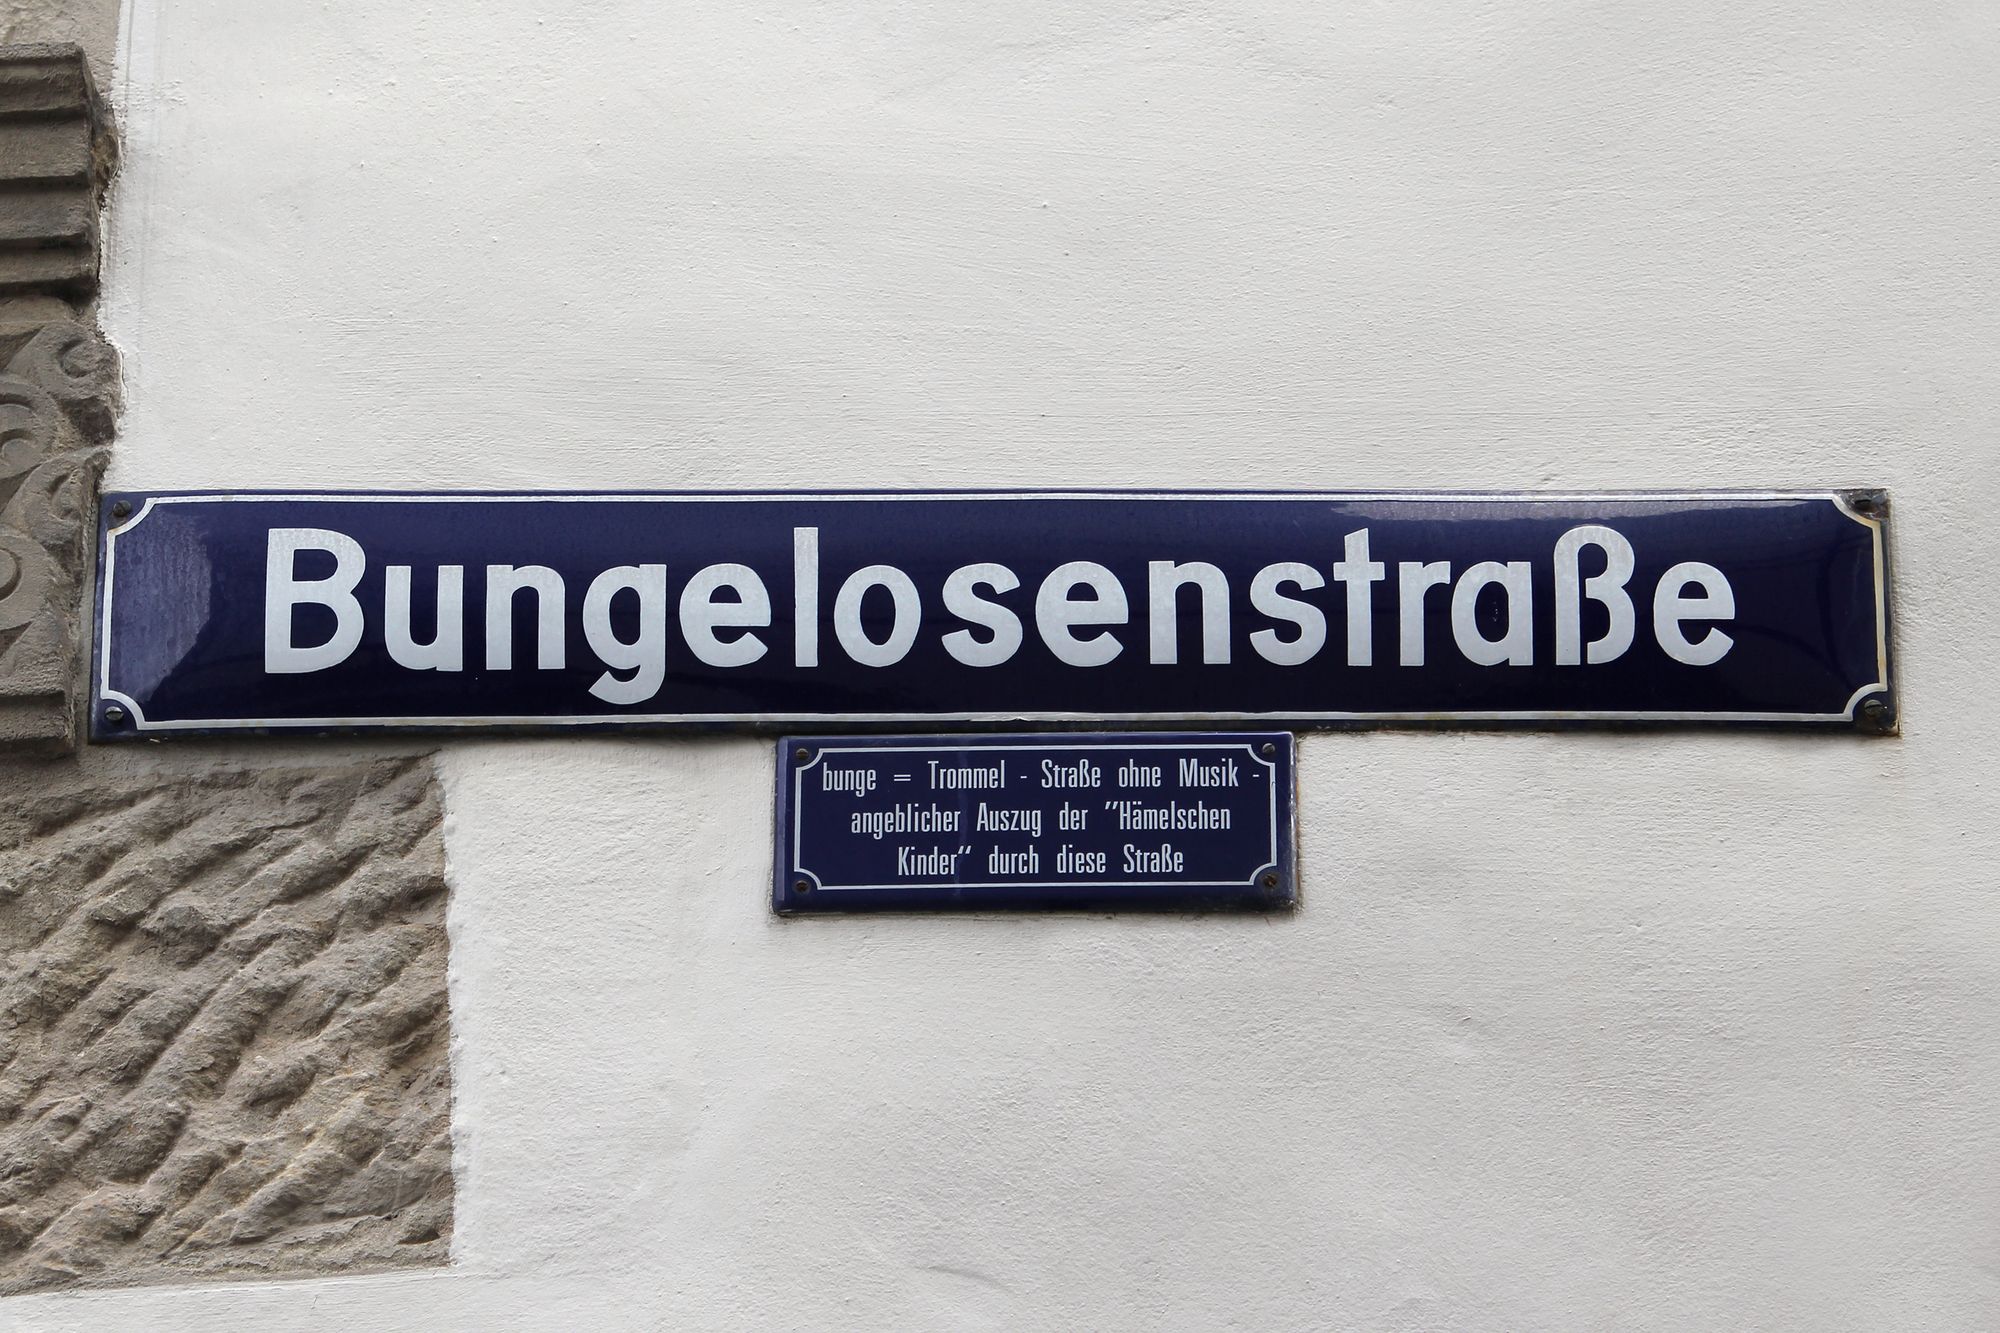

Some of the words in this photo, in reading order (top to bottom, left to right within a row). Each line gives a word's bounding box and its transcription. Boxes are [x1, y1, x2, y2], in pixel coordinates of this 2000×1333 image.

[264, 524, 1736, 705] Bungelosenstraße
[822, 762, 877, 798] bunge
[927, 759, 1005, 790] Trommel
[1041, 758, 1101, 788] Straße
[1118, 758, 1161, 788] ohne
[1179, 758, 1239, 788] Musik
[851, 803, 961, 840] angeblicher
[976, 802, 1042, 838] Auszug
[1059, 801, 1089, 831] der
[988, 845, 1039, 875] durch
[1056, 844, 1106, 874] diese
[1123, 843, 1184, 873] Straße
